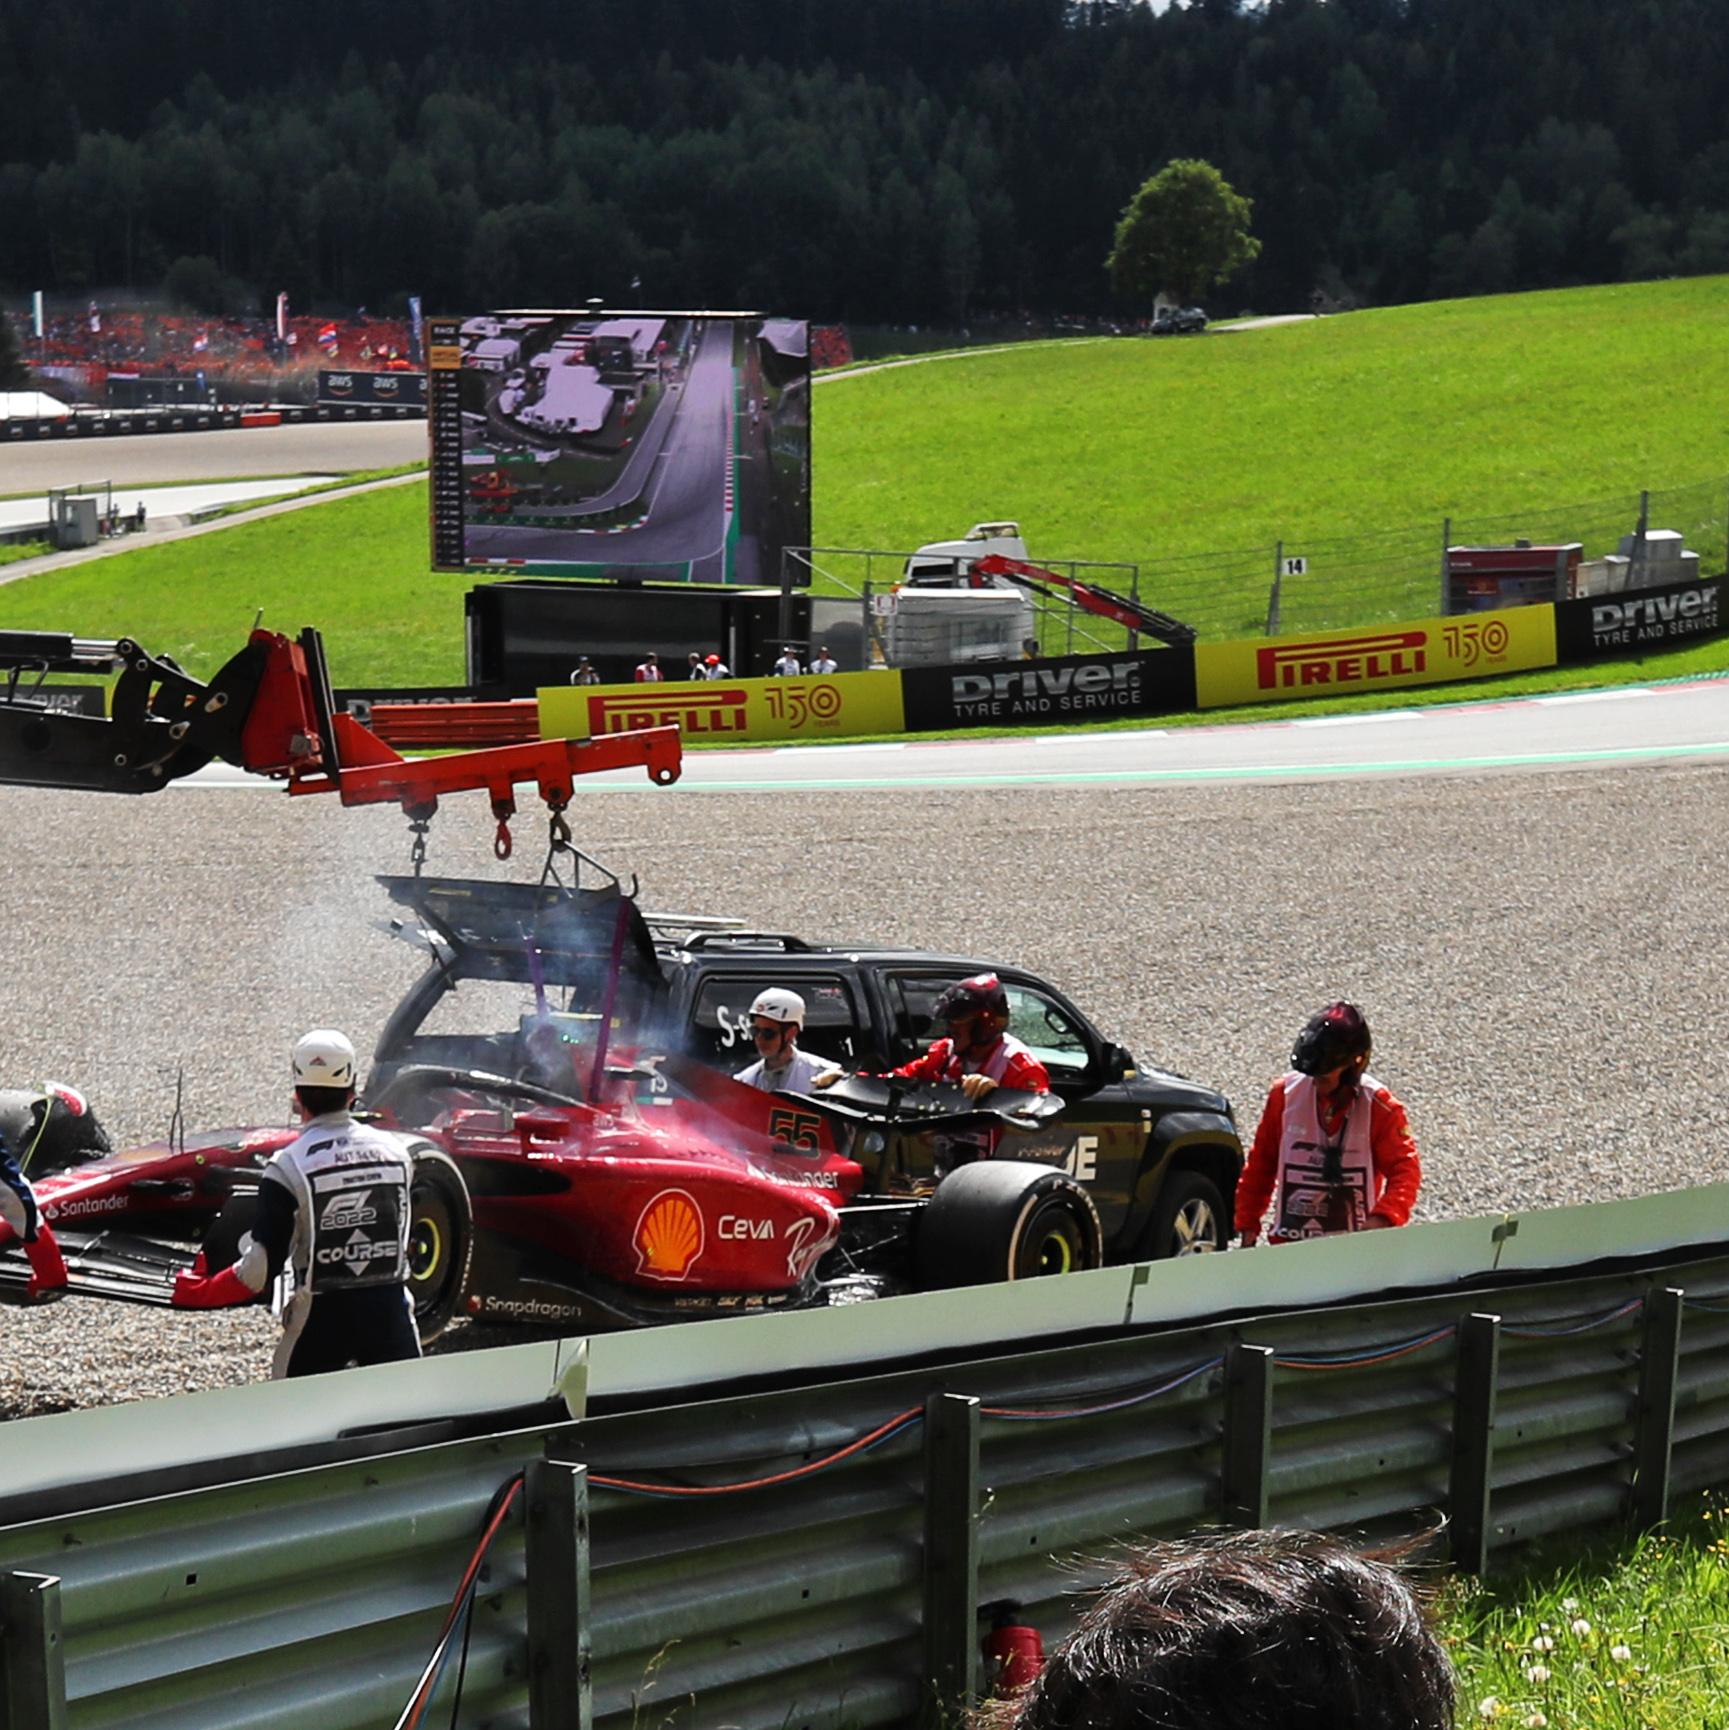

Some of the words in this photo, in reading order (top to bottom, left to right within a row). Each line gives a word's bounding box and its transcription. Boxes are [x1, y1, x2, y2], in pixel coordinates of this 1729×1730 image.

[1287, 559, 1302, 574] 14
[1593, 630, 1630, 646] TYRE
[1638, 624, 1664, 640] AND
[1670, 614, 1718, 635] SERVICE
[1257, 631, 1427, 689] PIRELLI
[1443, 621, 1508, 667] 150
[764, 684, 841, 728] 150
[954, 702, 1001, 717] TYRE
[1012, 699, 1051, 714] AND
[1061, 691, 1141, 710] SERVICE
[769, 1107, 821, 1160] 55
[60, 1195, 129, 1217] Santander
[321, 1207, 377, 1230] 2022
[317, 1240, 398, 1264] COURSE
[485, 1296, 582, 1319] Snapdragon
